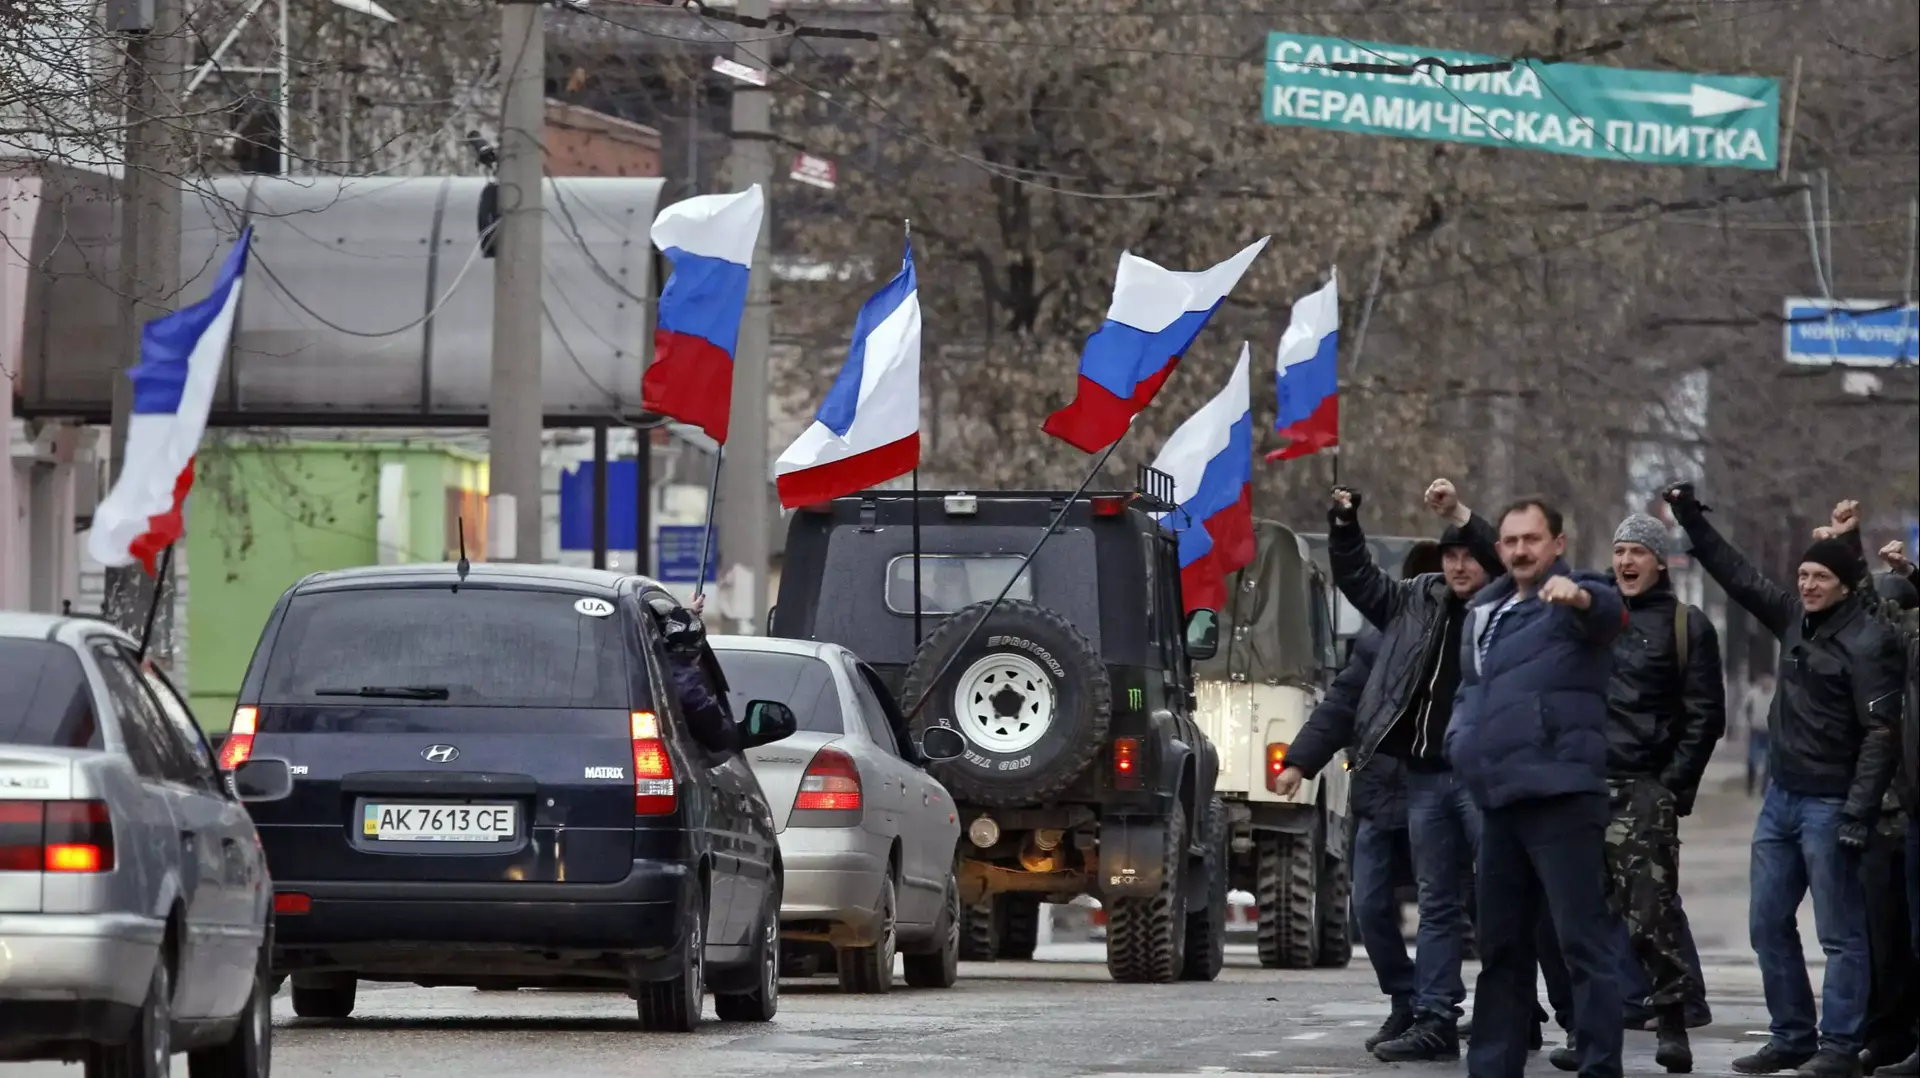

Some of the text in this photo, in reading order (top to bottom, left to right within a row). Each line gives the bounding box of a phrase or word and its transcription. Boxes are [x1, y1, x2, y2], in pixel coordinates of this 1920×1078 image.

[1275, 41, 1542, 99] САНТЕХНИКА
[1273, 85, 1767, 161] КЕРАМИЧЕСКАЯ ПЛИТКА
[583, 601, 607, 612] UA
[585, 766, 624, 779] MATRIX
[380, 809, 508, 832] AK 7613 CE
